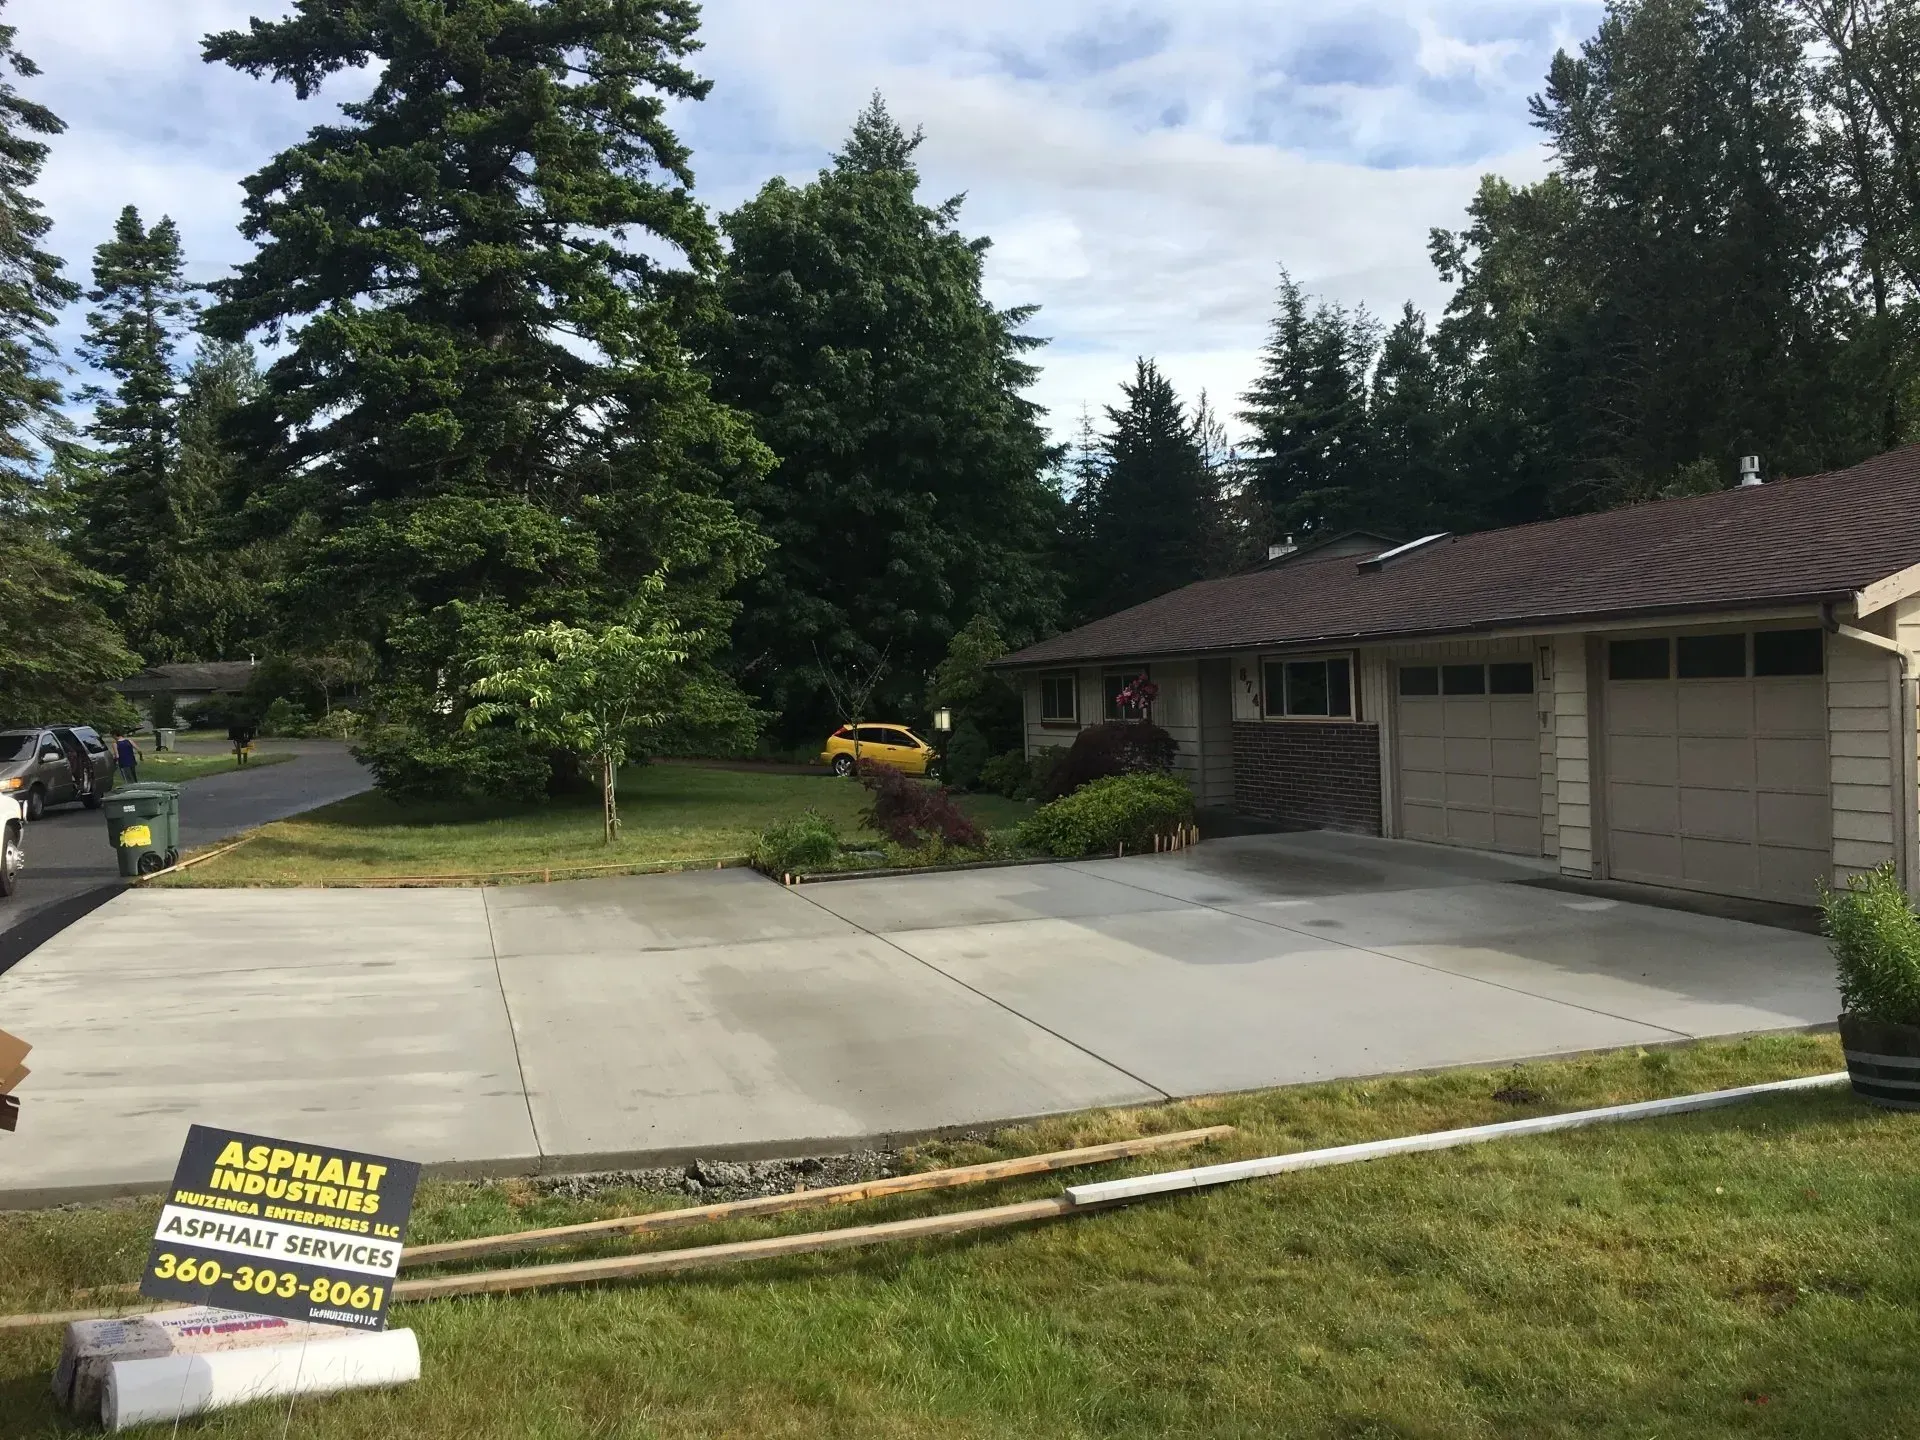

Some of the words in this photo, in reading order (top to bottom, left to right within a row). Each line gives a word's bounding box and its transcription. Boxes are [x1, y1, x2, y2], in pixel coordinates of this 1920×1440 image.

[209, 1168, 381, 1215] INDUSTRIES
[215, 1141, 388, 1192] ASPHALT
[174, 1190, 259, 1216] HUIZENGA
[264, 1206, 369, 1234] ENTERPRISES
[374, 1223, 400, 1239] LLC
[164, 1215, 279, 1250] ASPHALT
[284, 1234, 394, 1269] SERVICES
[154, 1253, 385, 1311] 360-303-8061
